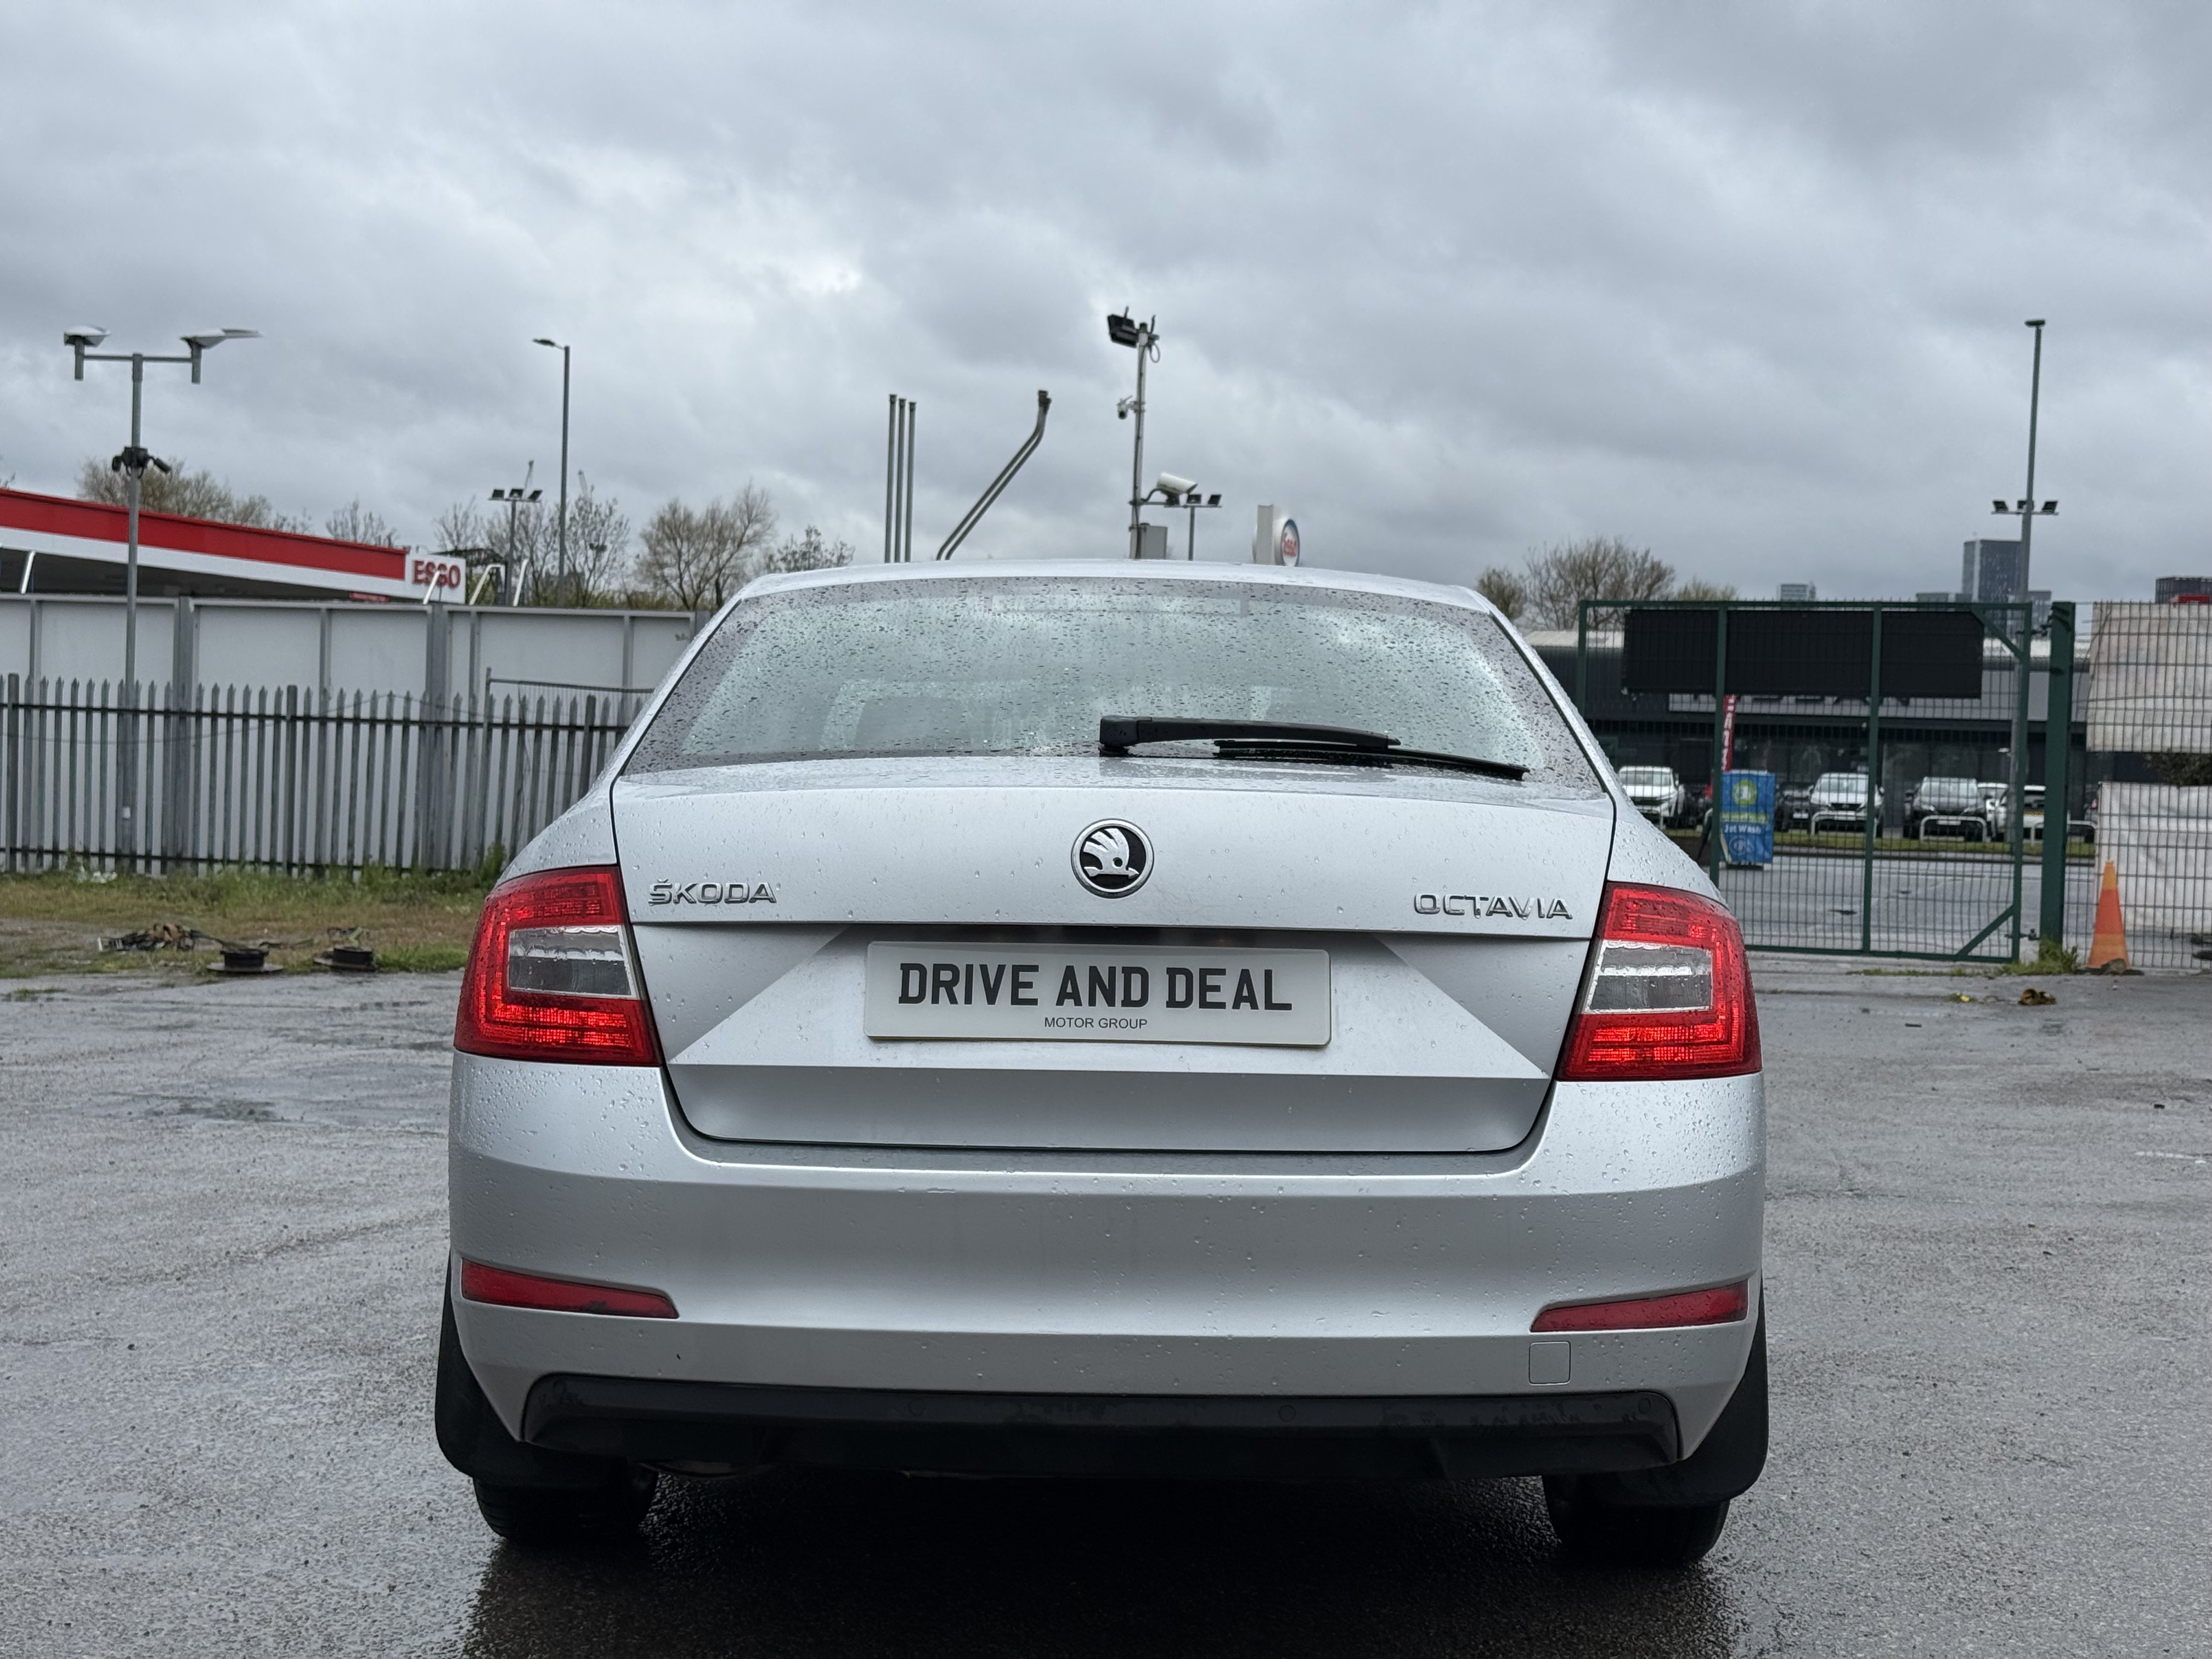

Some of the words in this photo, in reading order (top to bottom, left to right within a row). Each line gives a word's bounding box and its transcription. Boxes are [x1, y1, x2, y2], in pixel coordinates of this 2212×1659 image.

[413, 560, 461, 589] ESSO
[648, 879, 777, 904] ŠKODA
[1414, 893, 1573, 919] OCTAVIA
[899, 963, 1039, 1006] DRIVE
[1056, 966, 1149, 1007] AND
[1166, 967, 1292, 1011] DEAL
[1045, 1017, 1094, 1028] MOTOR
[1098, 1018, 1148, 1029] GROUP
